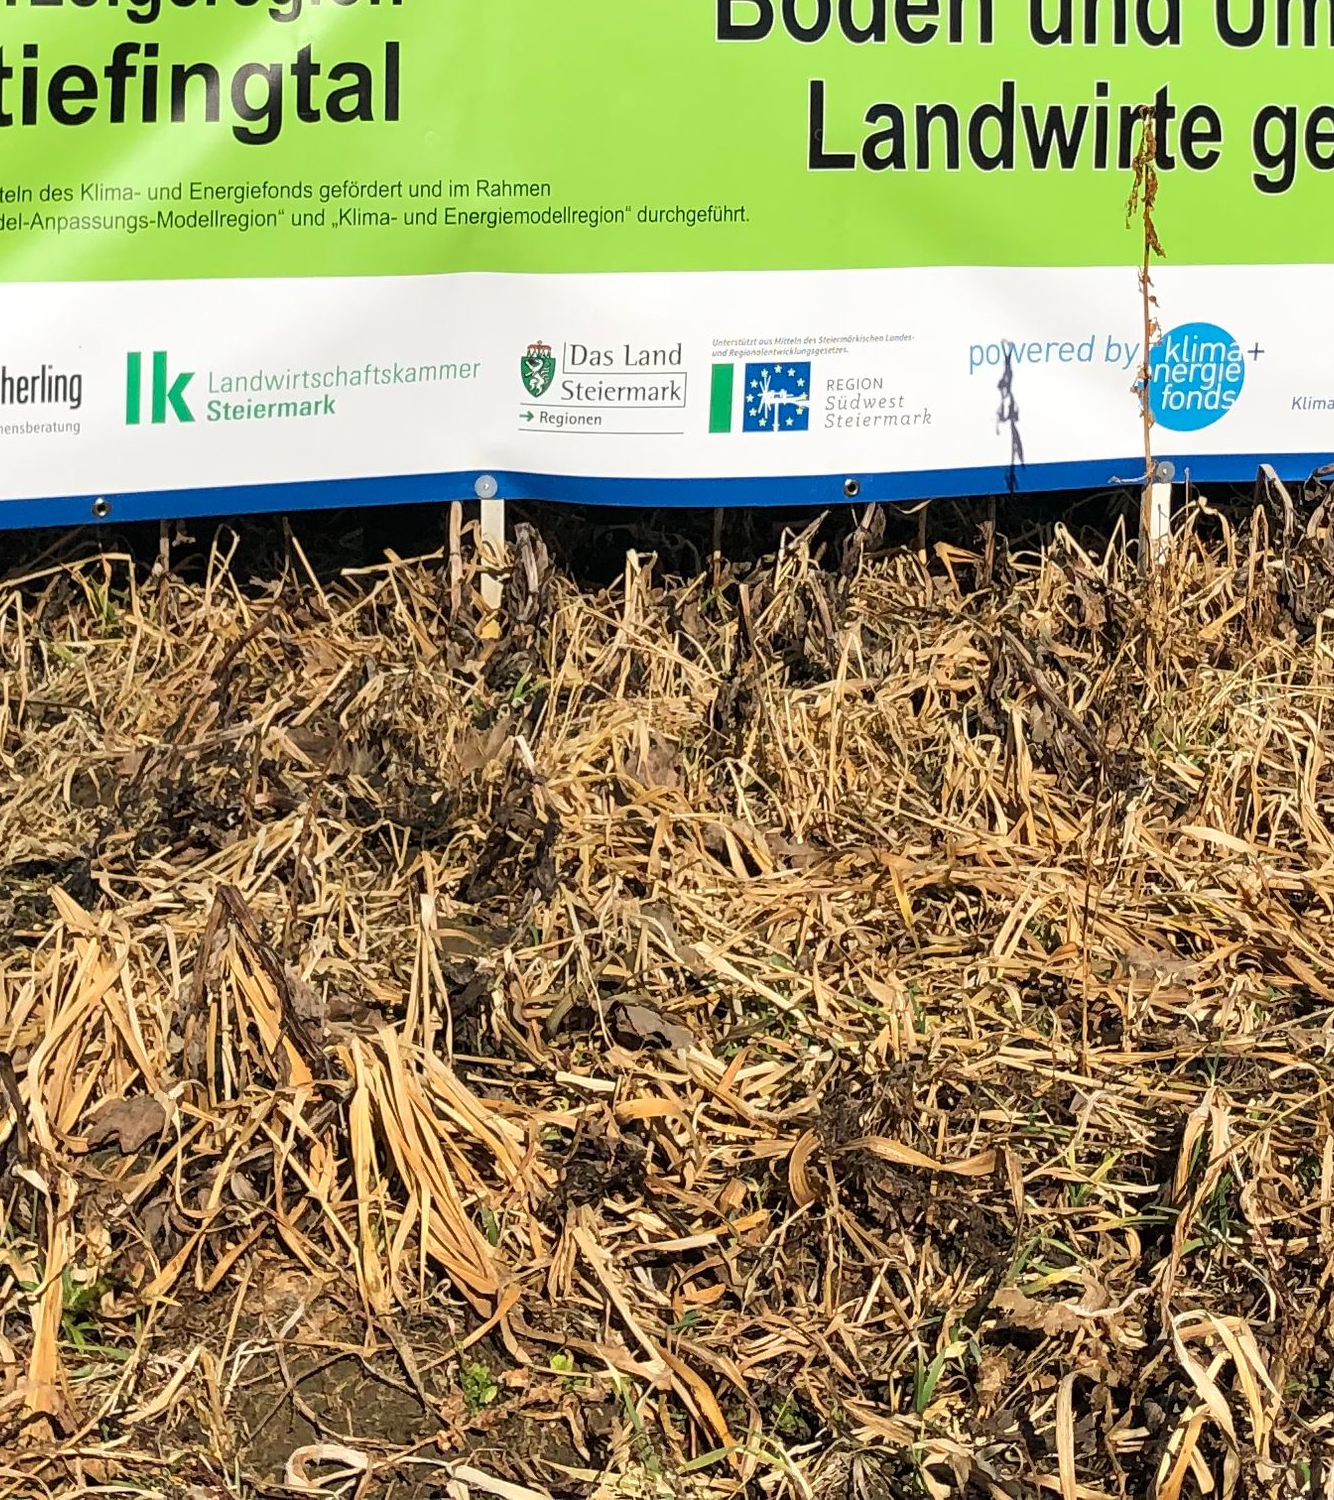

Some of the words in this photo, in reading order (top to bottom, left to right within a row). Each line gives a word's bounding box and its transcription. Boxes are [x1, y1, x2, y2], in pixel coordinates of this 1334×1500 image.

[809, 81, 1221, 170] Landwirte
[40, 184, 73, 202] des
[81, 183, 140, 201] Klima-
[148, 182, 181, 200] und
[190, 181, 312, 204] Energiefonds
[320, 180, 402, 205] gefördert
[409, 180, 441, 197] und
[450, 180, 469, 197] im
[477, 180, 550, 196] Rahmen
[292, 209, 324, 226] und
[405, 208, 437, 225] und
[638, 201, 749, 227] durchgeführt.
[712, 338, 757, 347] Unterstützt
[759, 338, 772, 346] aus
[774, 337, 802, 345] Mitteln
[804, 336, 816, 344] des
[712, 349, 727, 358] und
[1165, 335, 1242, 362] klima
[571, 344, 614, 366] Das
[624, 343, 682, 366] Land
[970, 335, 1095, 374] powered
[1105, 335, 1140, 370] by
[209, 359, 480, 394] Landwirtschaftskammer
[827, 378, 883, 391] REGION
[561, 380, 681, 401] Steiermark
[825, 392, 905, 410] Südwest
[1161, 384, 1237, 410] fonds
[207, 394, 335, 421] Steiermark
[540, 411, 602, 428] Regionen
[825, 408, 932, 428] Steiermark
